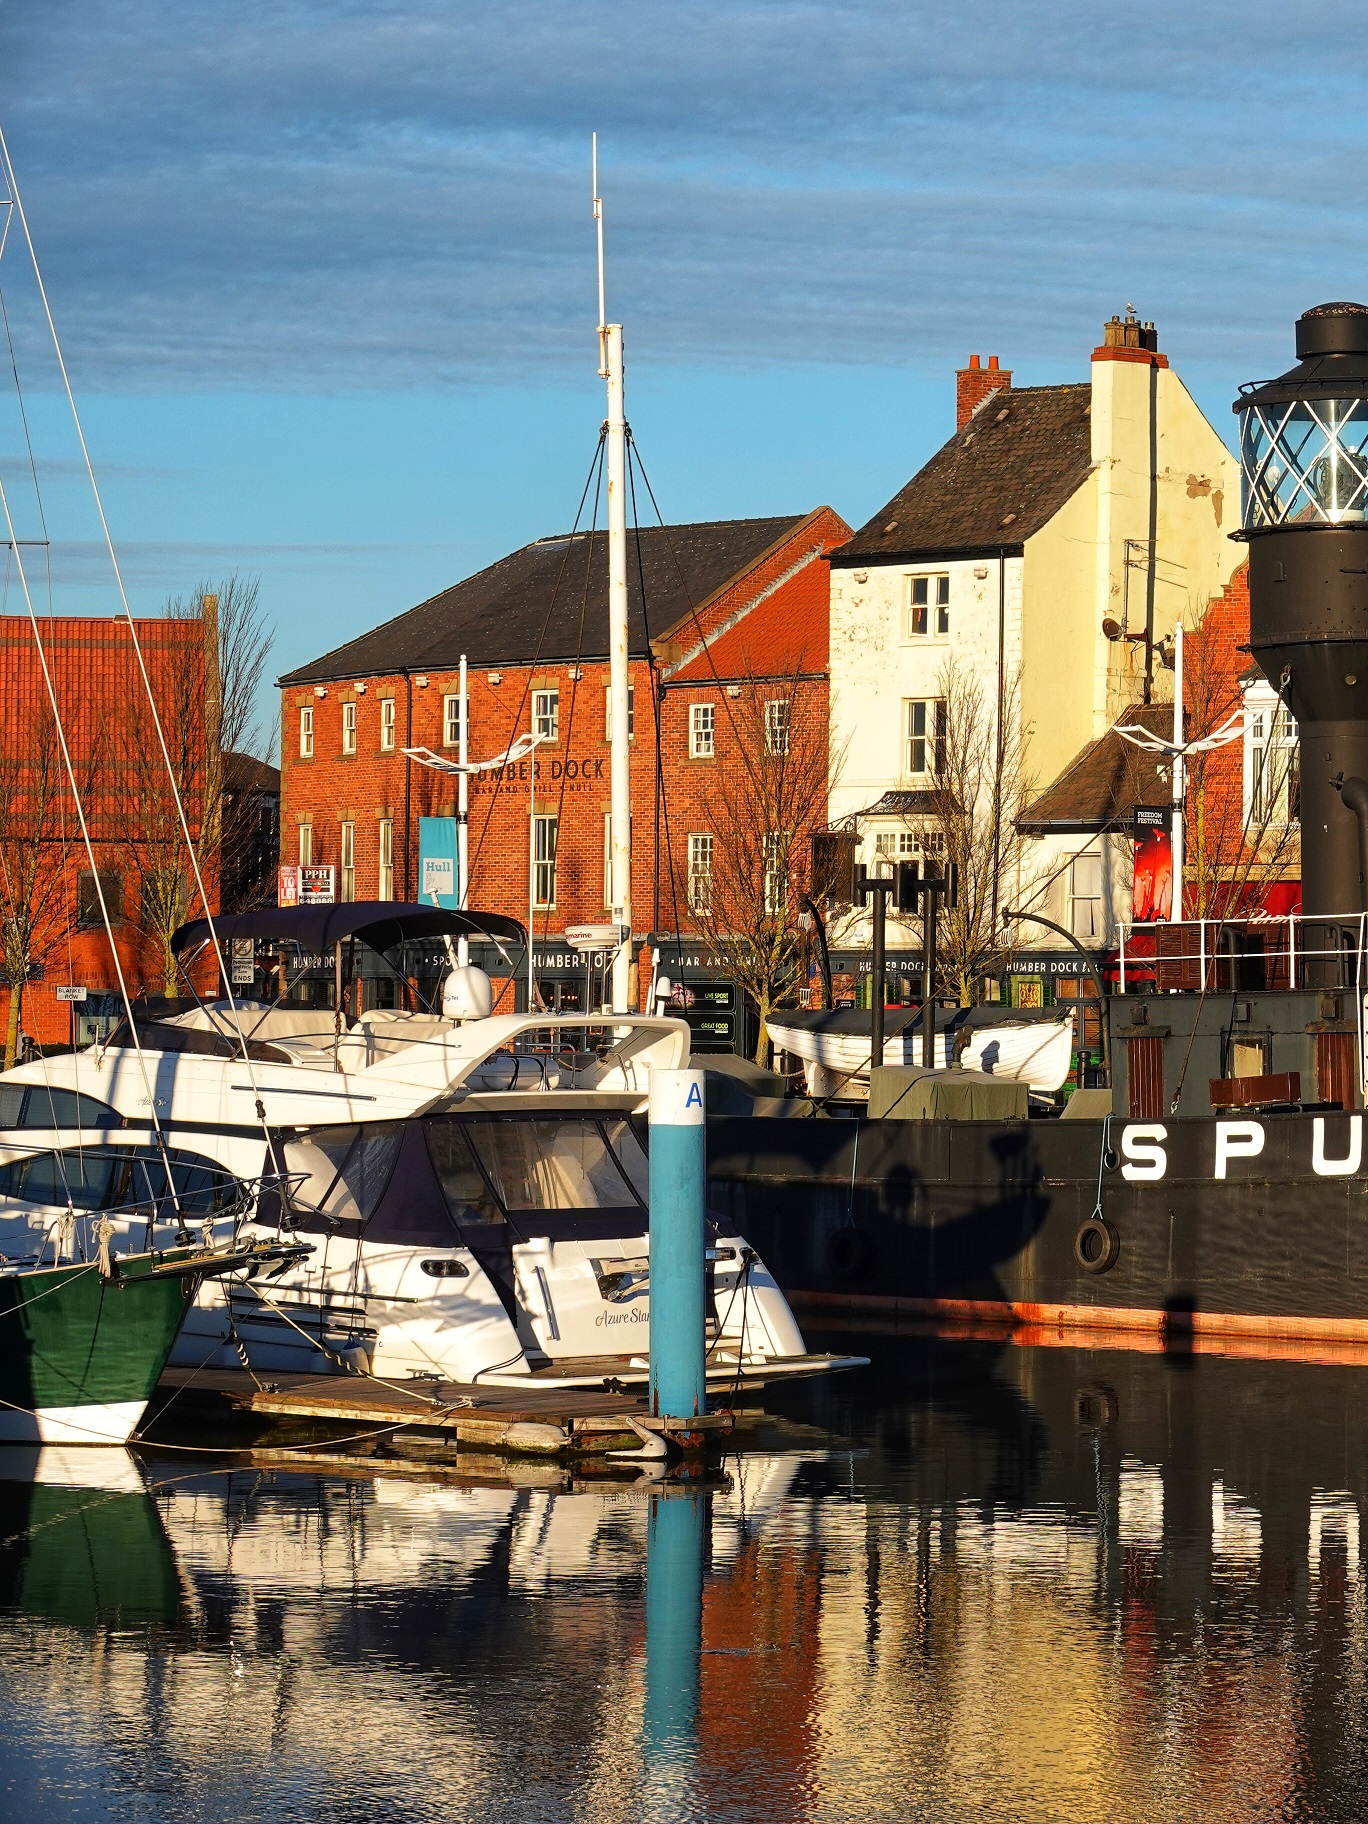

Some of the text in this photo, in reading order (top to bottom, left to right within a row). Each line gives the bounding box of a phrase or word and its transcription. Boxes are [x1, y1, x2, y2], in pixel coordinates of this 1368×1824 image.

[551, 759, 604, 779] DOCK
[474, 785, 493, 794] BAR
[499, 786, 518, 794] AND
[569, 783, 594, 791] HULL
[1137, 811, 1163, 819] FREEDOM
[426, 862, 451, 872] Hull
[304, 869, 328, 879] PPH
[283, 876, 295, 888] TO
[281, 888, 297, 900] LET
[532, 954, 579, 968] HUMBER
[1006, 962, 1047, 972] HUMBER
[1051, 962, 1078, 972] DOCK
[685, 1082, 703, 1108] A
[595, 1309, 629, 1328] Azure
